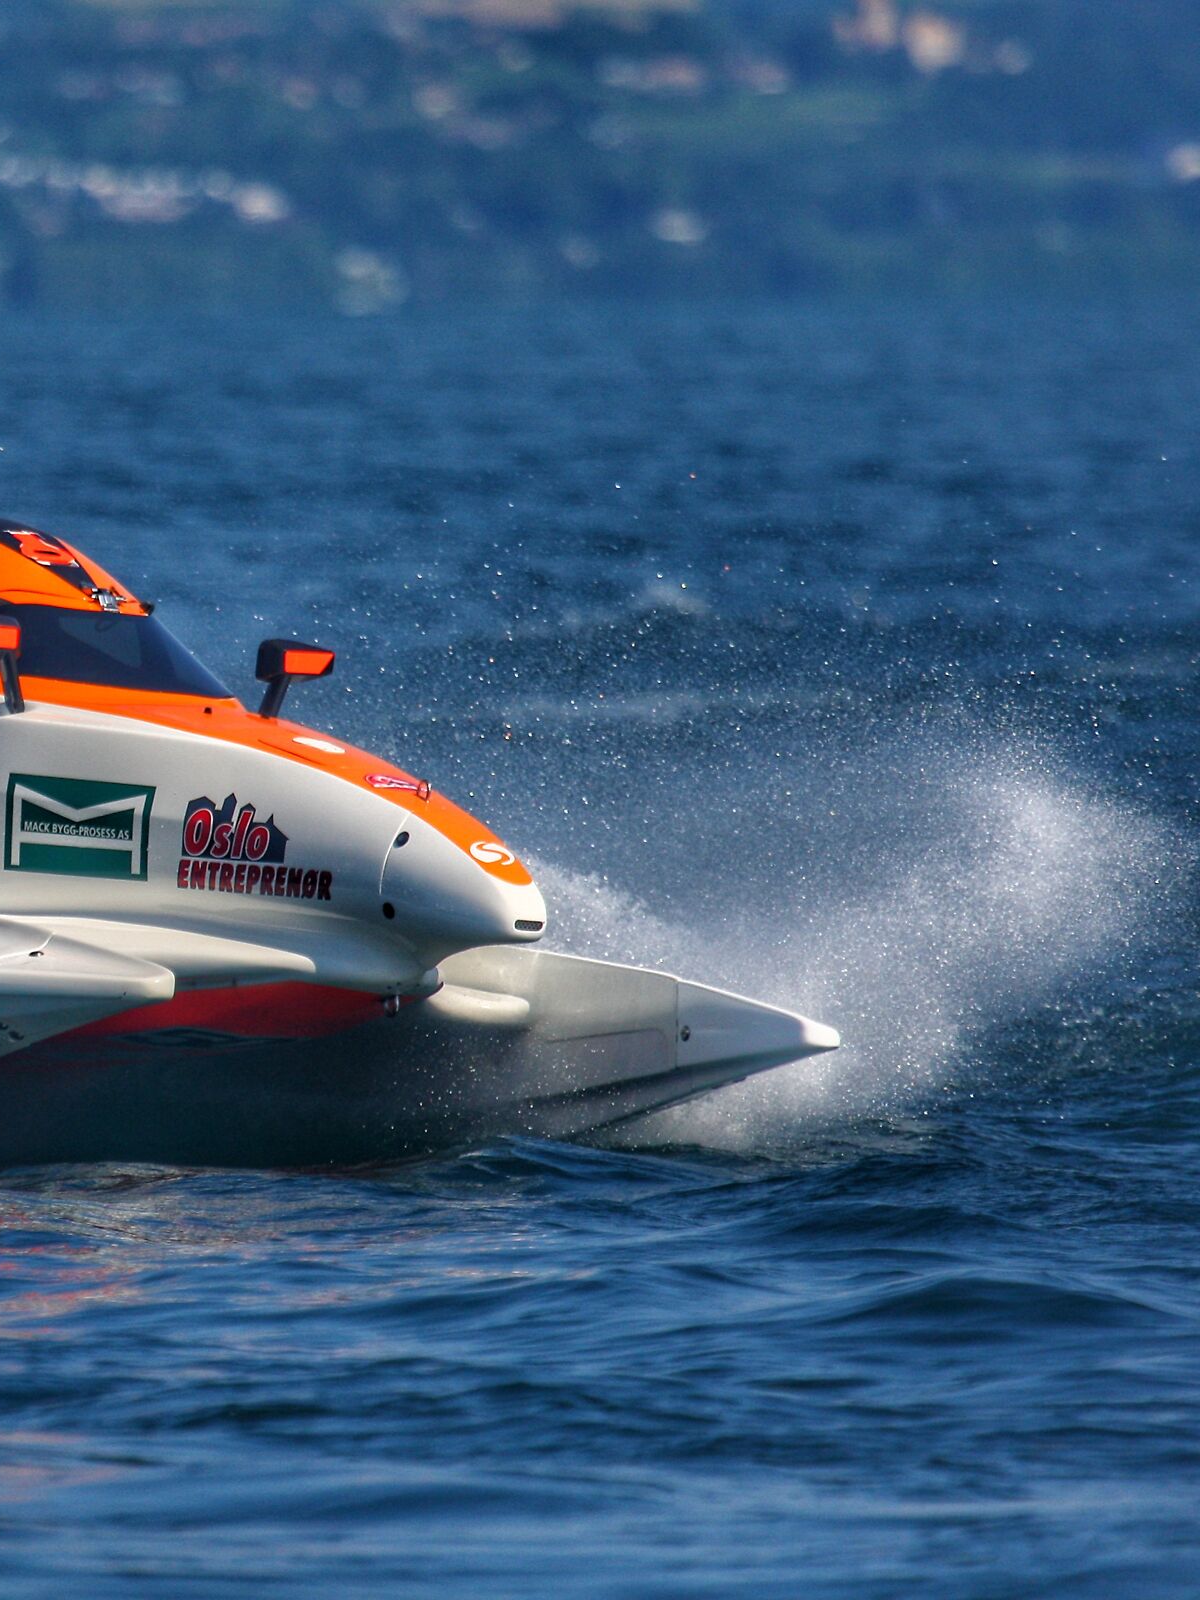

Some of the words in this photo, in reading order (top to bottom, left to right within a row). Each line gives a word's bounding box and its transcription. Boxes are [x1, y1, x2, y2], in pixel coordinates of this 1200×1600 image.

[23, 821, 50, 833] MACK
[52, 824, 116, 838] BYGG-PROSESS
[117, 829, 130, 840] AS
[183, 808, 270, 861] Oslo
[176, 858, 333, 901] ENTREPRENØR
